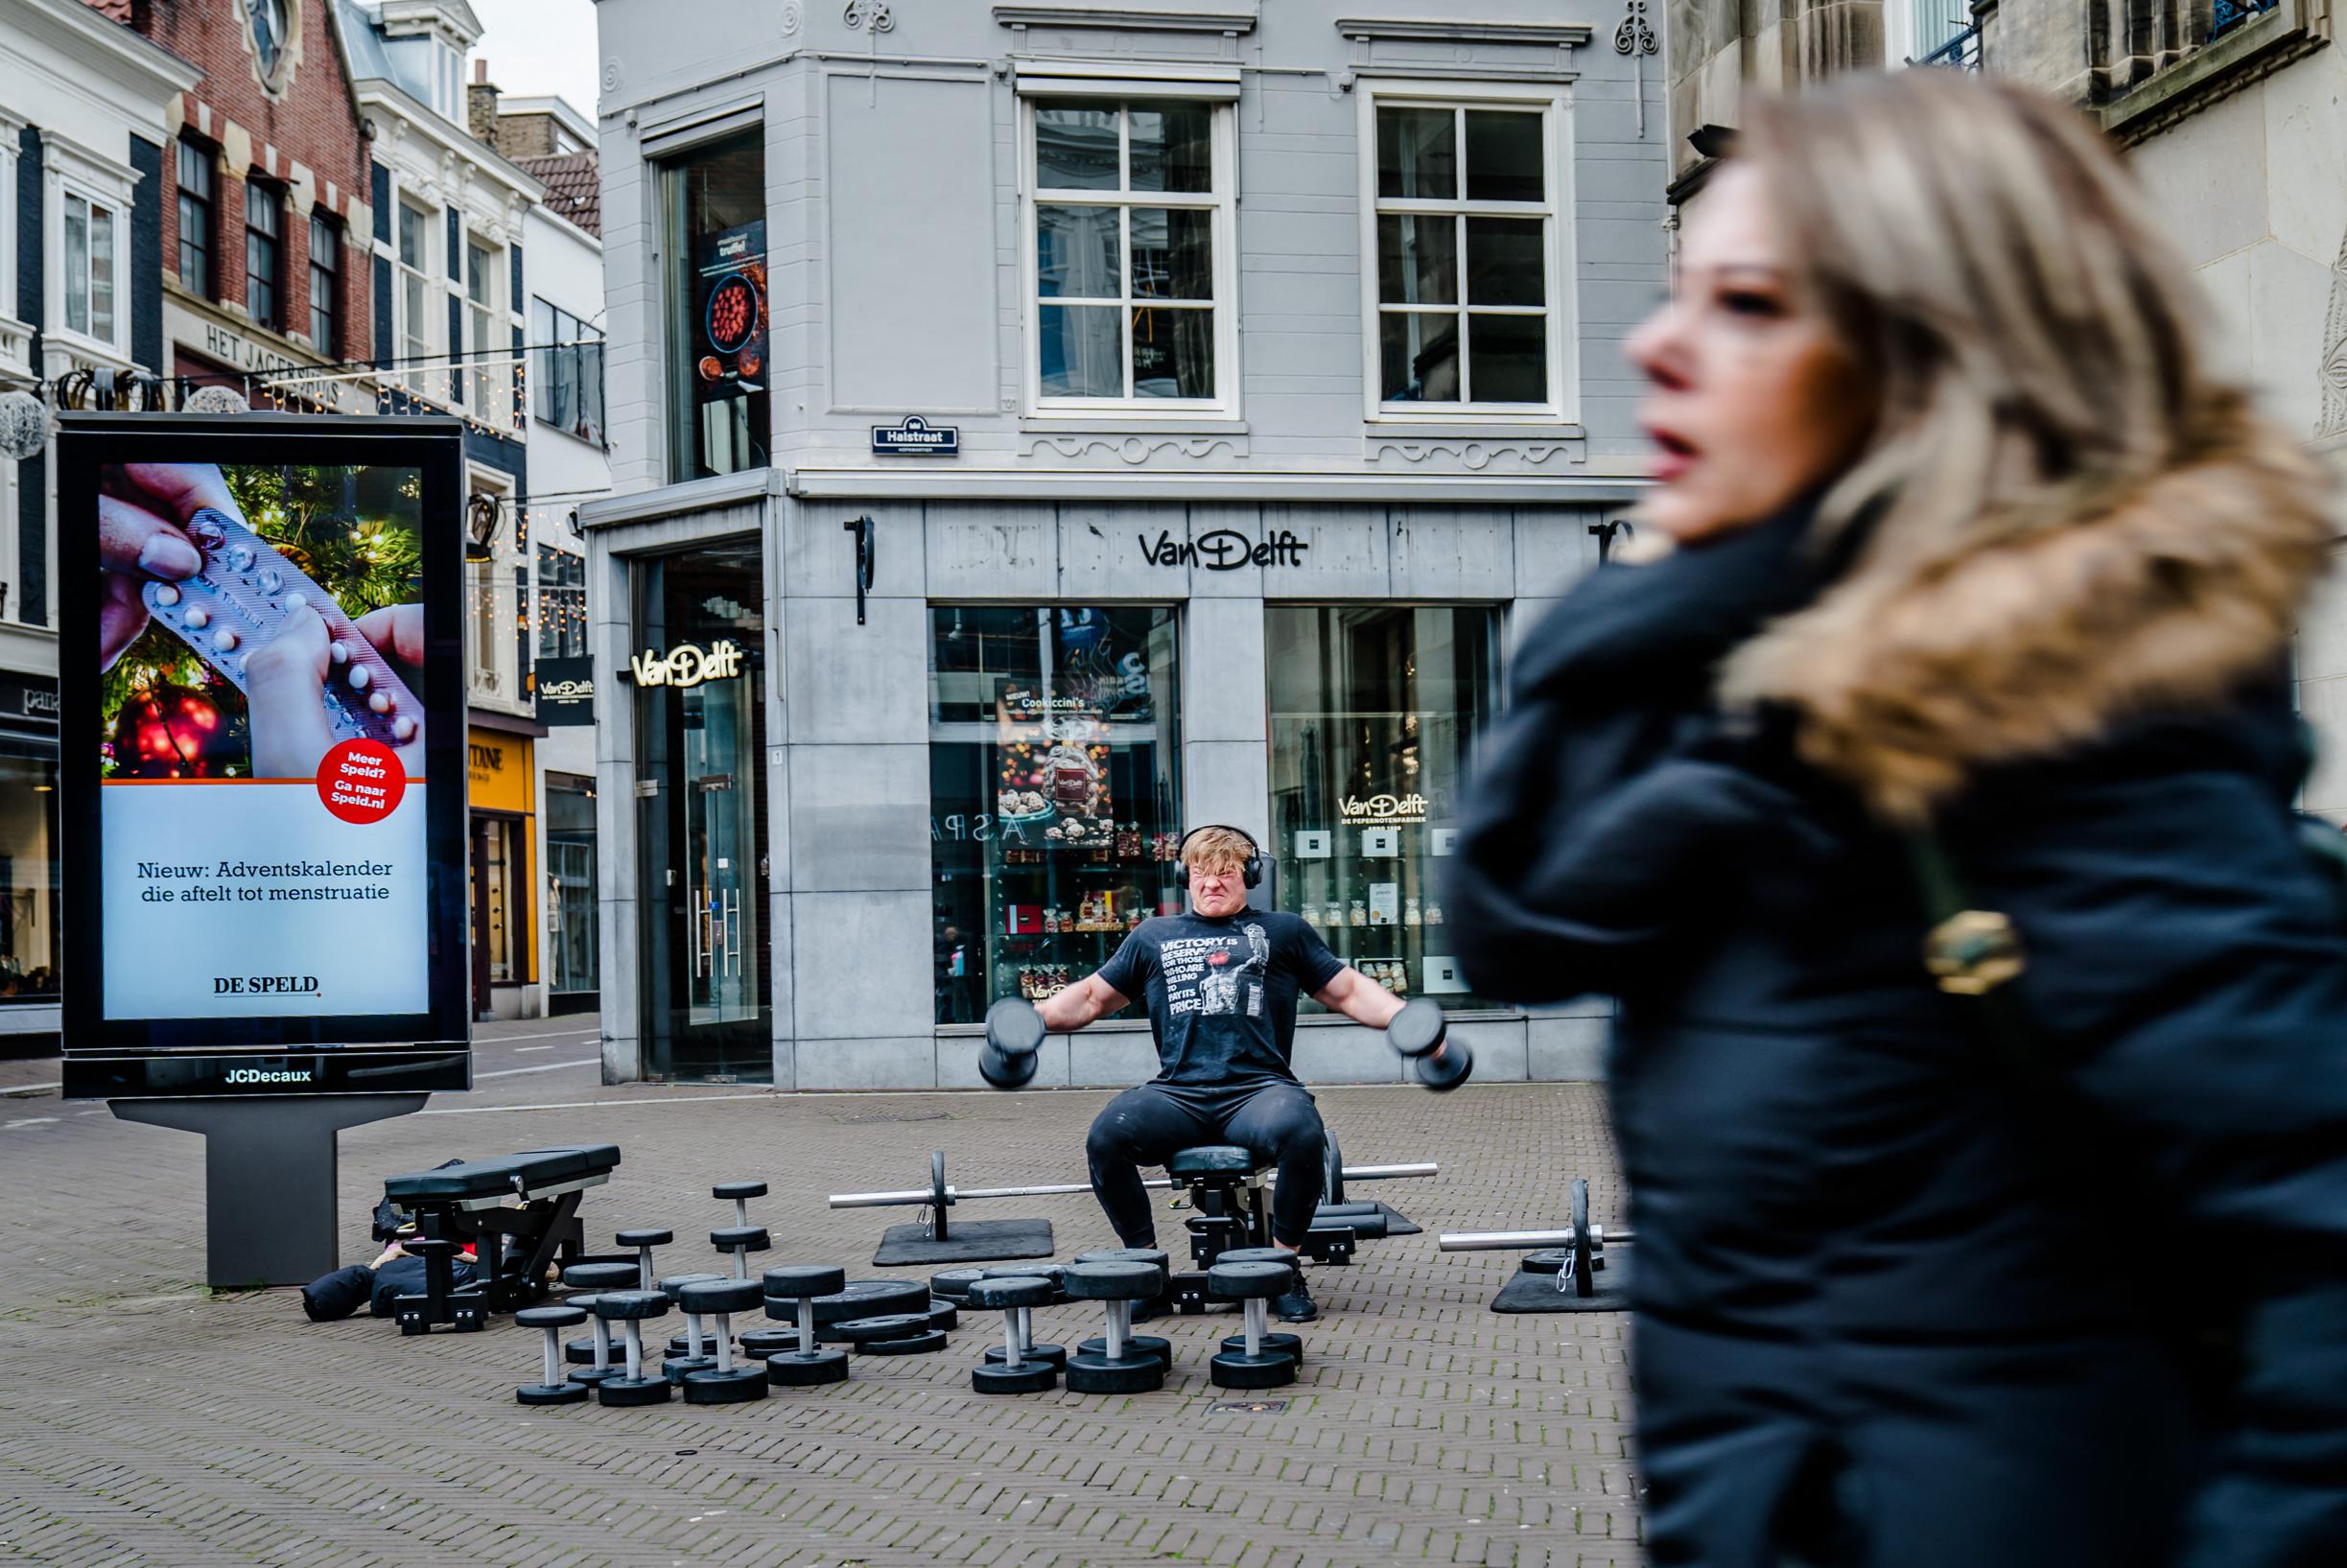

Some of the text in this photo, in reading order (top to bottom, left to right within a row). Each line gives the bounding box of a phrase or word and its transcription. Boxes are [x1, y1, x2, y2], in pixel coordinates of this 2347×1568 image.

[206, 324, 240, 362] HET
[887, 431, 943, 442] Halstraat
[1021, 697, 1085, 708] Cookiccini's
[348, 752, 383, 766] Meer
[340, 763, 387, 779] Speld?
[335, 780, 387, 797] Ga naar
[331, 792, 386, 809] Speld.nl
[137, 860, 393, 878] Nieuw: Adventskalender
[141, 883, 389, 901] die aftelt tot menstruatie
[1161, 937, 1227, 952] VICTORY
[1162, 956, 1205, 969] FOR THOSE
[1163, 963, 1205, 976] WHO ARE
[214, 977, 244, 994] DE
[1166, 972, 1198, 985] WILLING
[1167, 984, 1177, 993] TO
[1168, 989, 1196, 1002] PAY ITS
[225, 1068, 312, 1084] JCDecaux
